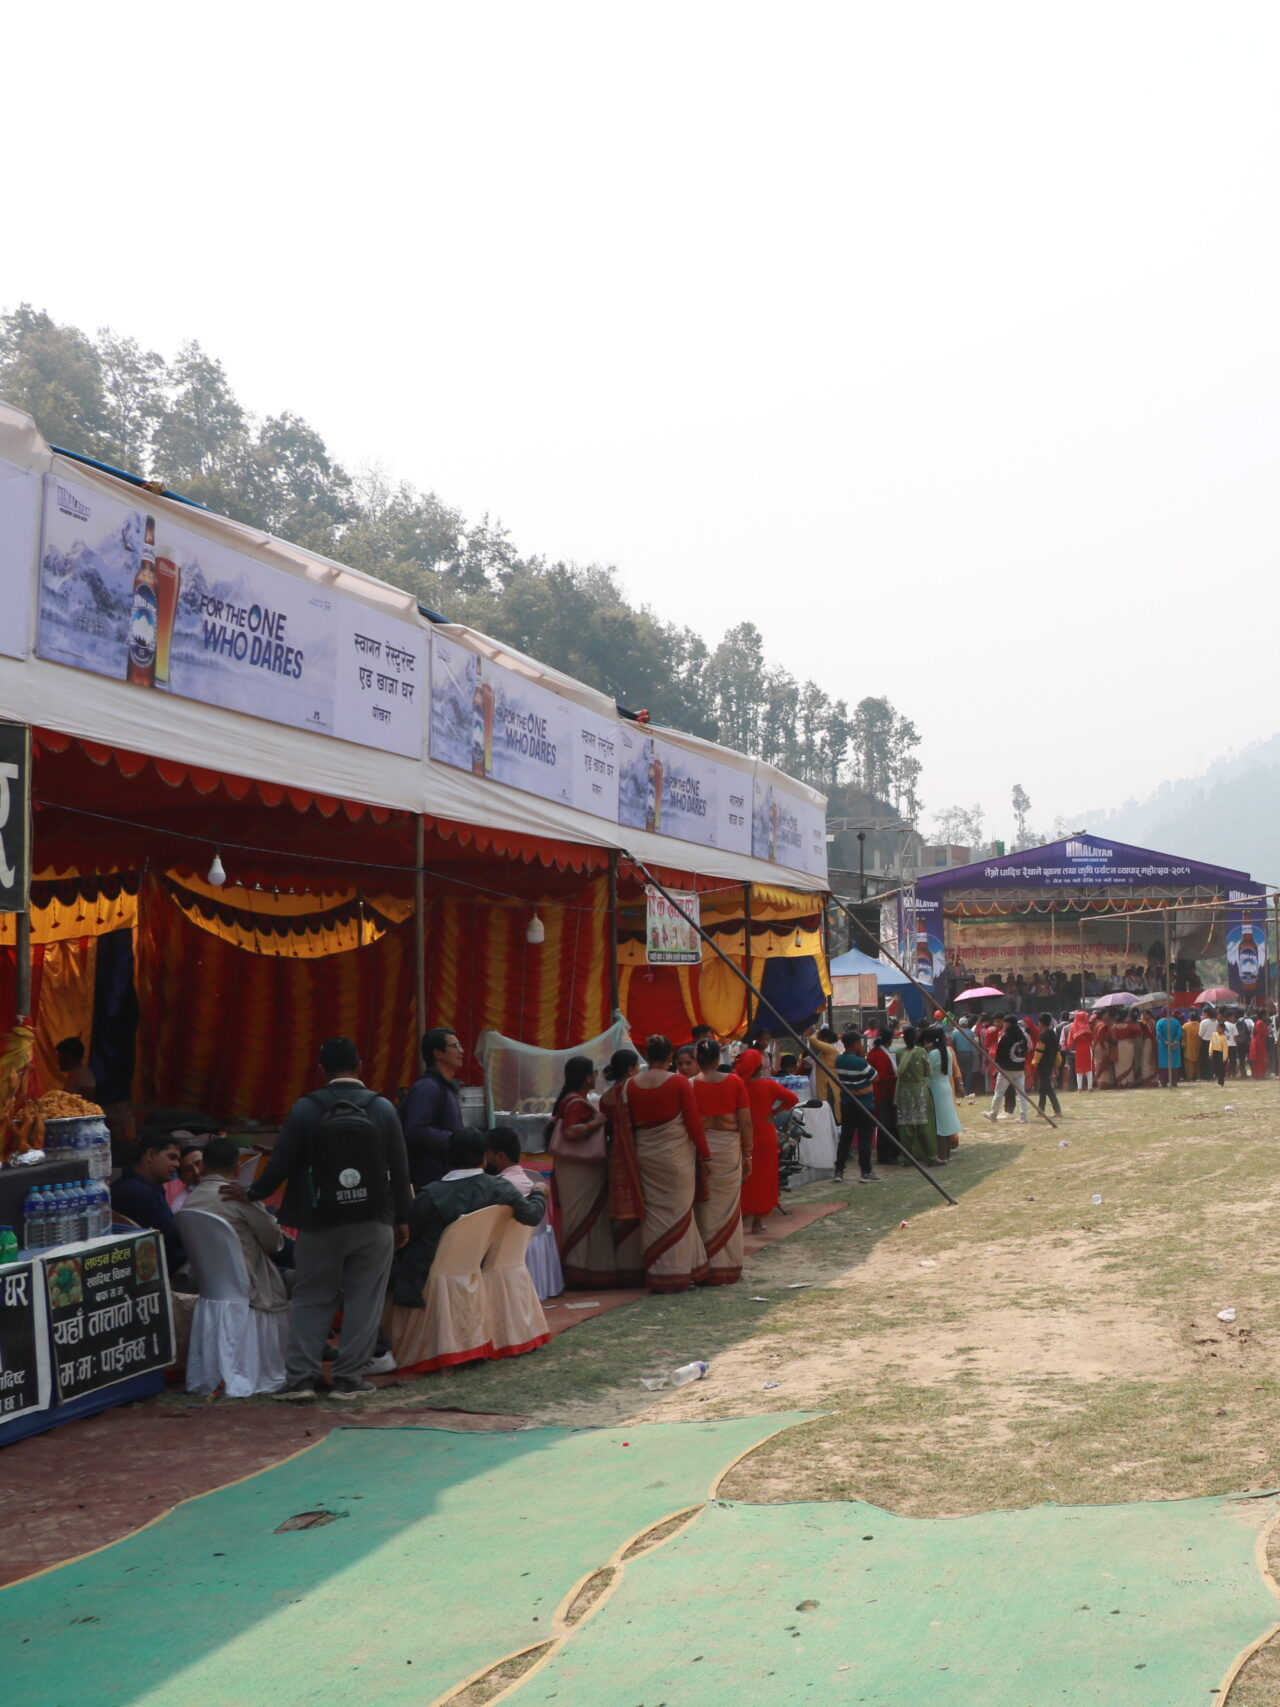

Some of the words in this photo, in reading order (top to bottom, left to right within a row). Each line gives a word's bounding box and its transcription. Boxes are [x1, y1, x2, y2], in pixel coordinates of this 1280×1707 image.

[200, 594, 224, 620] FOR
[226, 603, 247, 628] THE
[248, 604, 287, 642] ONE
[204, 620, 248, 661] WHO
[249, 635, 304, 679] DARES
[354, 632, 382, 659] स्वागत
[377, 673, 399, 696] खाजा
[402, 682, 415, 704] घर
[516, 713, 527, 731] THE
[528, 713, 547, 739] ONE
[506, 726, 528, 754] WHO
[529, 736, 557, 766] DARES
[686, 777, 701, 797] ONE
[1065, 841, 1113, 857] HIMALAYAN
[111, 1247, 131, 1264] होटल
[5, 1272, 29, 1307] घर
[53, 1307, 85, 1345] यहाँ
[136, 1292, 160, 1325] सुप
